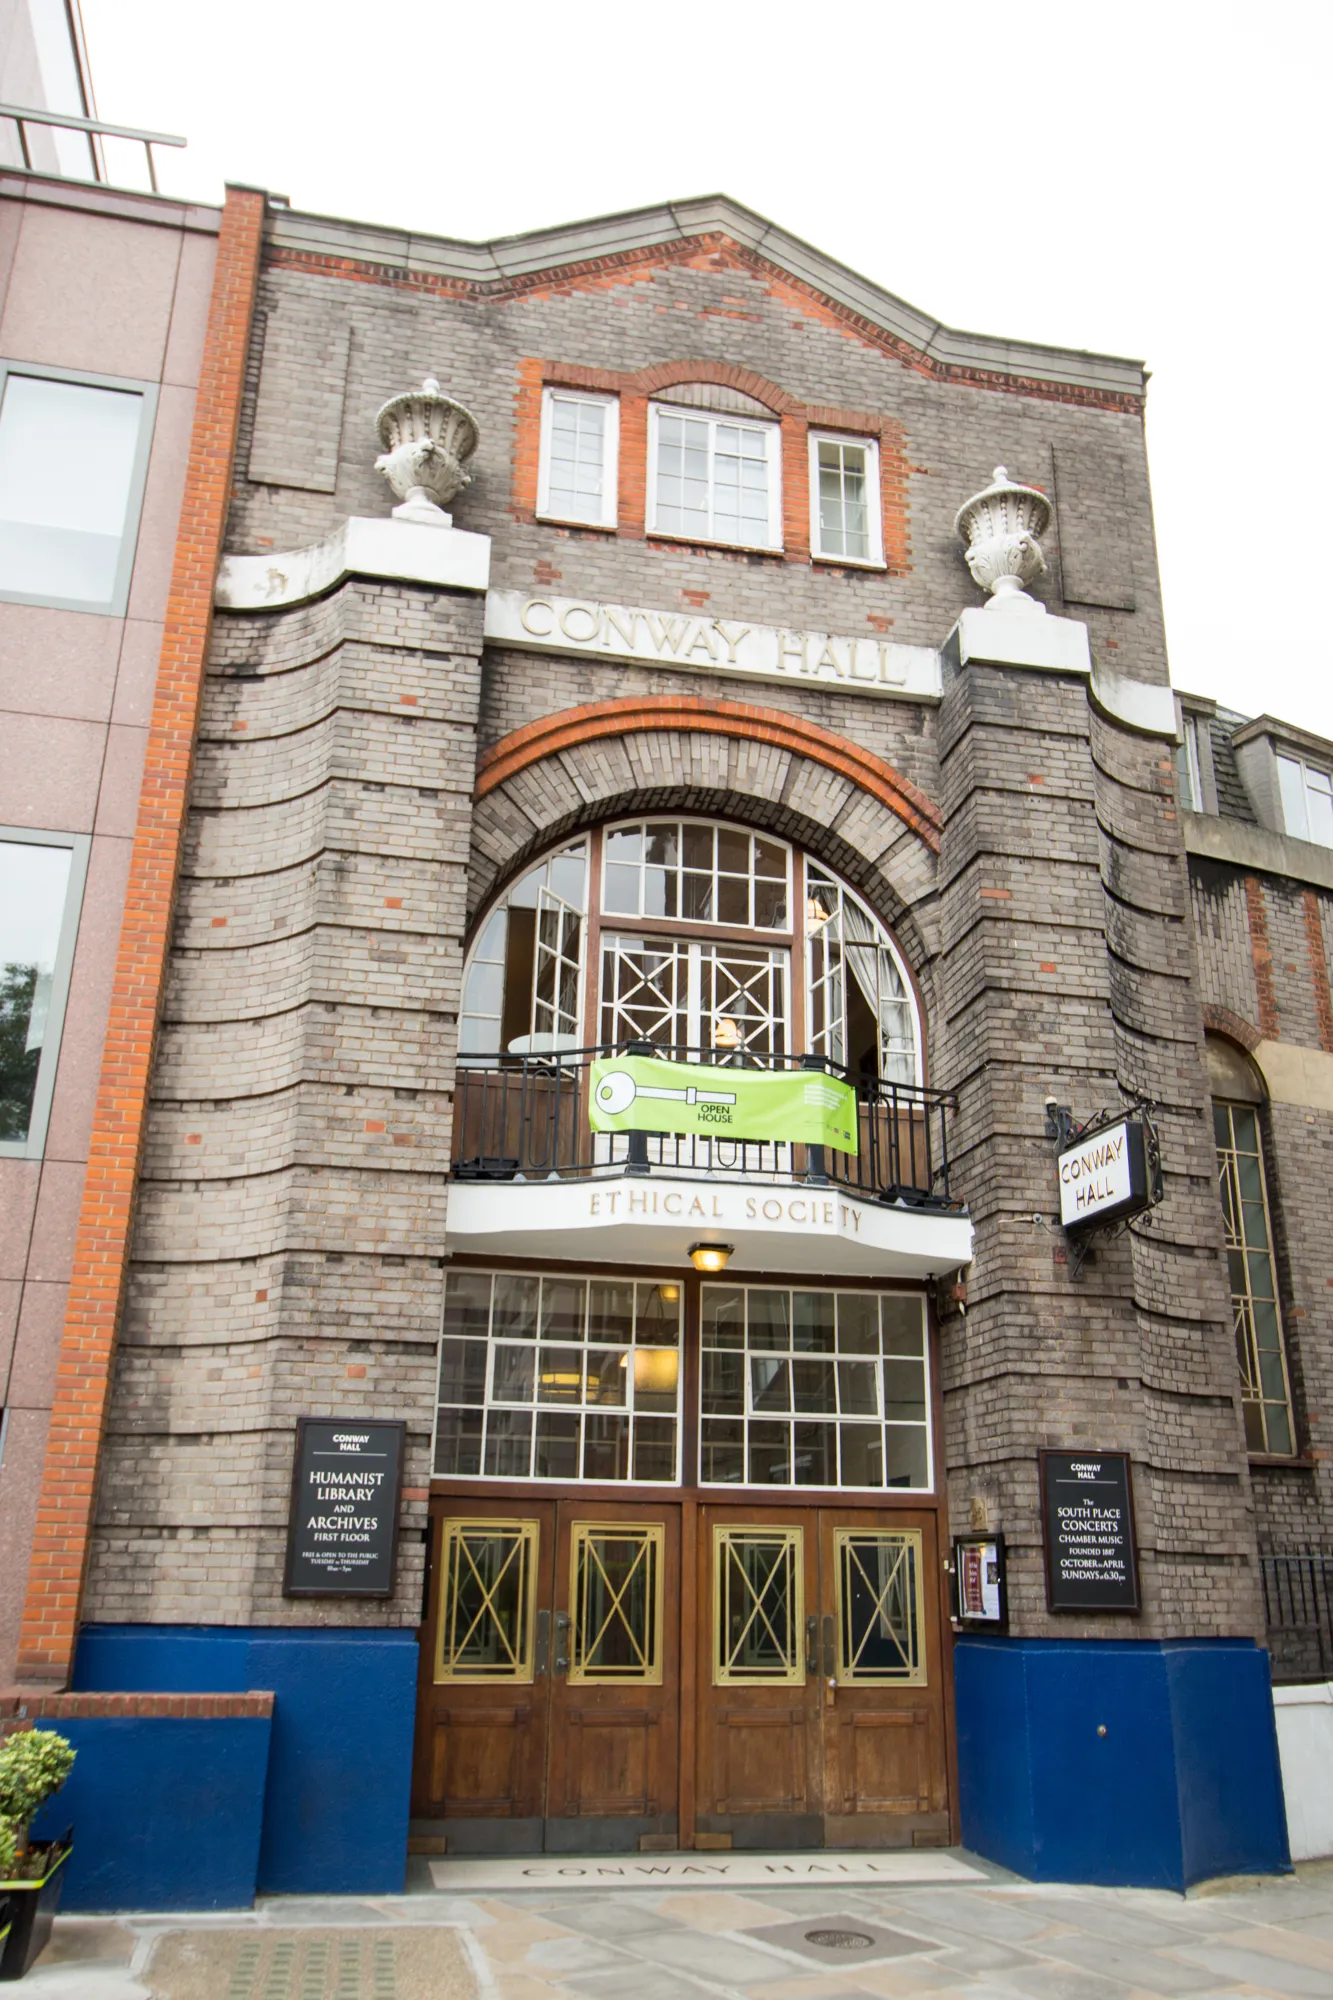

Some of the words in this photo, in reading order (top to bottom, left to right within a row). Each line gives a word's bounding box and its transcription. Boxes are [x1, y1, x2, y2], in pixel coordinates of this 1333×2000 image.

[520, 598, 750, 663] CONWAY
[775, 632, 907, 685] HALL
[701, 1104, 730, 1115] OPEN
[697, 1112, 733, 1124] HOUSE
[1062, 1136, 1123, 1183] CONWAY
[1076, 1176, 1114, 1210] HALL
[590, 1190, 723, 1217] ETHICAL
[746, 1197, 863, 1232] SOCIETY
[332, 1434, 370, 1443] CONWAY
[340, 1443, 361, 1452] HALL
[1070, 1463, 1101, 1471] CONWAY
[309, 1471, 384, 1486] HUMANIST
[317, 1487, 375, 1501] LIBRARY
[1083, 1498, 1094, 1506] The
[333, 1504, 355, 1513] AND
[1057, 1507, 1090, 1518] SOUTH
[1093, 1508, 1121, 1519] PLACE
[307, 1516, 378, 1530] ARCHIVES
[1061, 1520, 1118, 1532] CONCERTS
[314, 1532, 339, 1542] FIRST
[340, 1532, 370, 1542] FLOOR
[1058, 1534, 1097, 1544] CHAMBER
[1098, 1535, 1123, 1545] MUSIC
[359, 1552, 379, 1560] PUBLIC
[1069, 1547, 1101, 1556] FOUNDED
[1060, 1558, 1098, 1568] OCTOBER
[1103, 1559, 1126, 1569] APRIL
[1061, 1569, 1100, 1580] SUNDAYS
[521, 1864, 731, 1878] CONWAY
[764, 1863, 893, 1874] HALL
